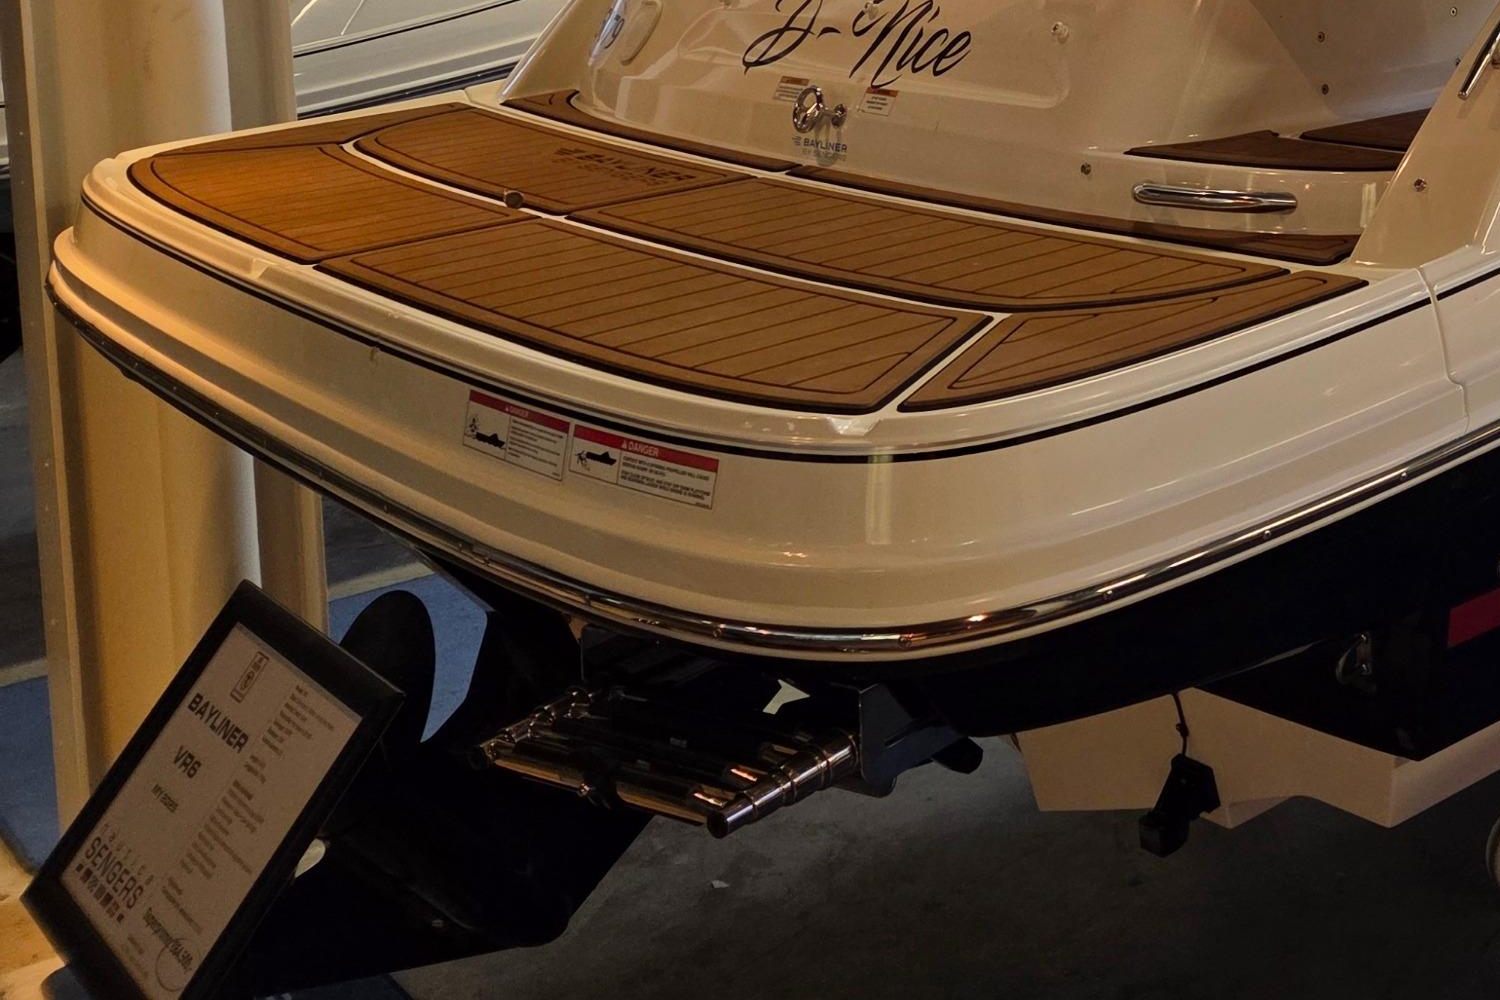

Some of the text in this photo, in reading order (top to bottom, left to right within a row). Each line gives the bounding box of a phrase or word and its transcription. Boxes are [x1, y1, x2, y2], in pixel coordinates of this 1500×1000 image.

[803, 136, 848, 153] BAYLINER
[627, 440, 660, 458] DANGER
[188, 693, 249, 753] BAYLINER
[172, 745, 202, 778] VR6
[84, 836, 145, 909] SENGERS
